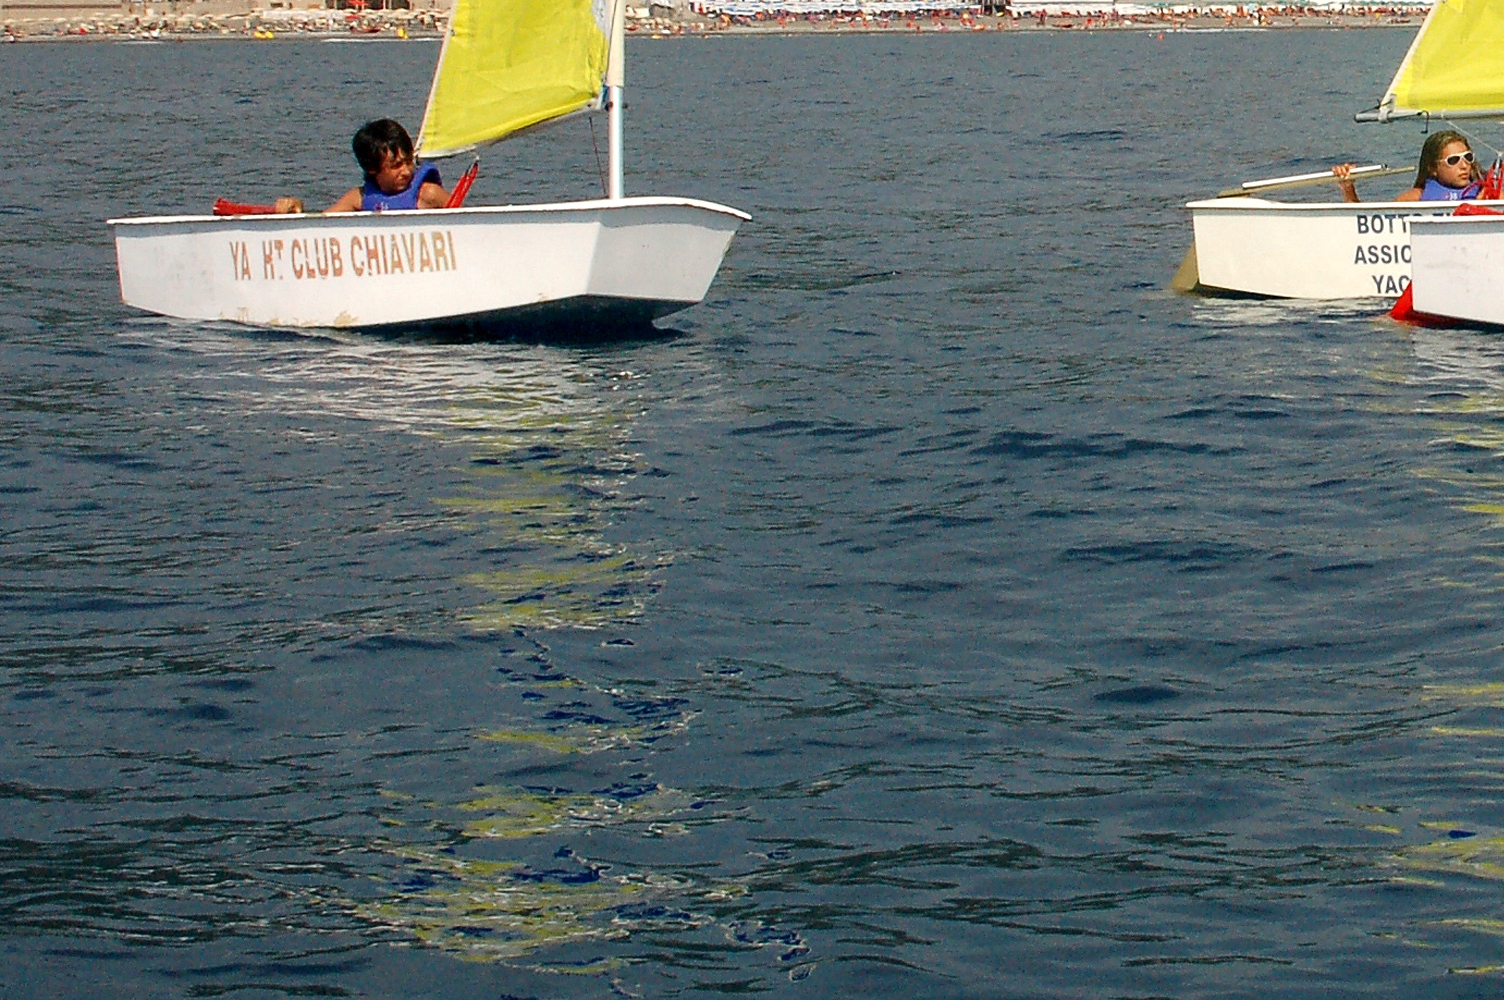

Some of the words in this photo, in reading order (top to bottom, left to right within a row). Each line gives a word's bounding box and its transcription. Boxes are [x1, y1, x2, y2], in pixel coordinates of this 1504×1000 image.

[1356, 213, 1424, 234] BOTT
[229, 240, 284, 280] YAHT
[291, 237, 344, 279] CLUB
[350, 230, 457, 276] CHIAVARI
